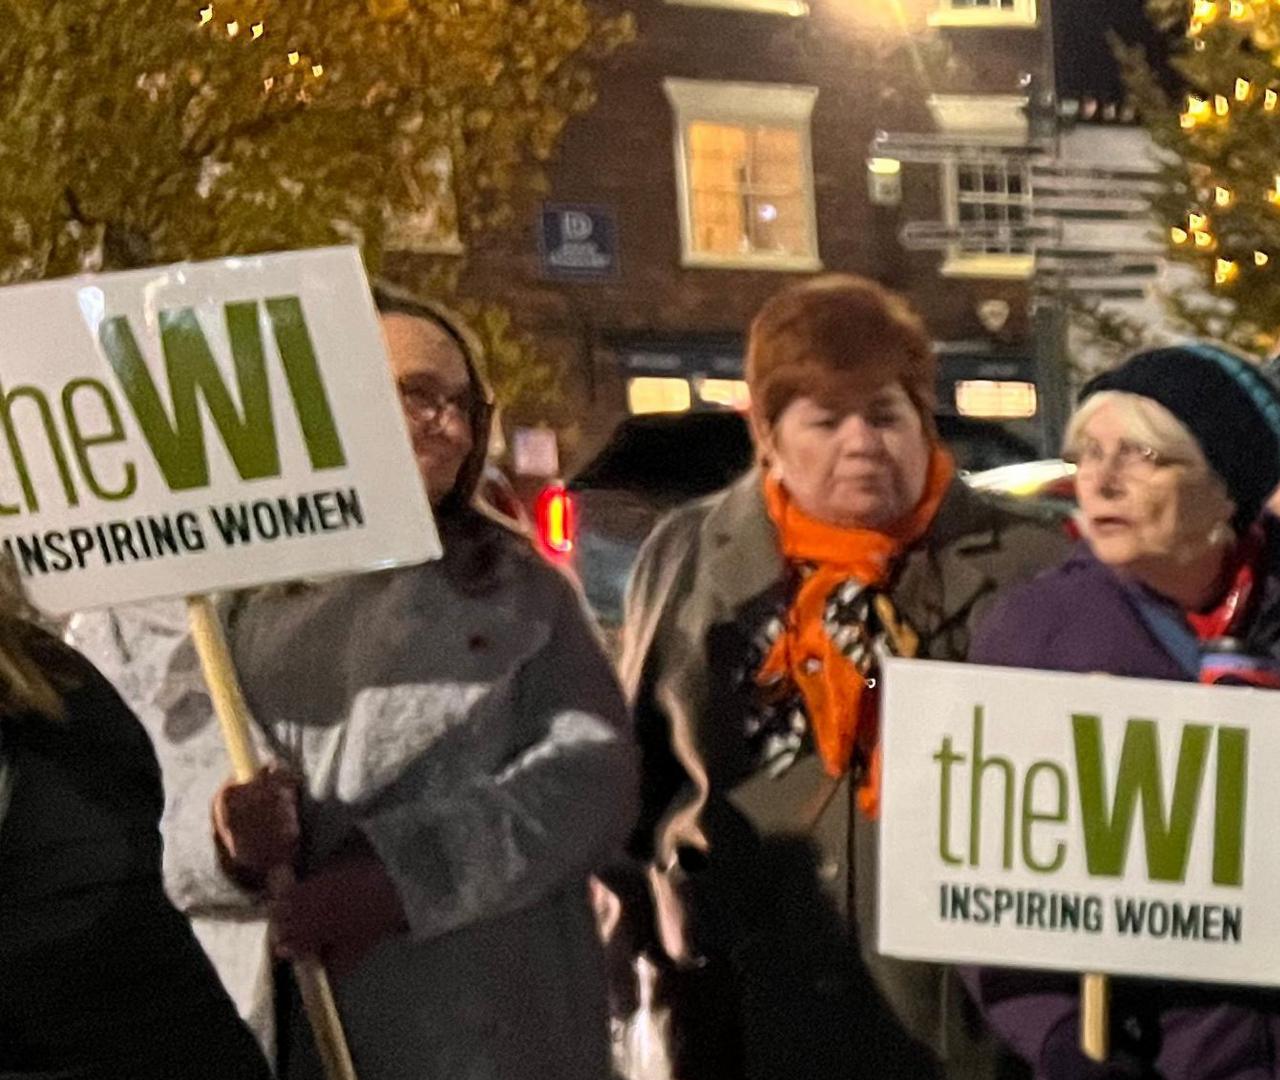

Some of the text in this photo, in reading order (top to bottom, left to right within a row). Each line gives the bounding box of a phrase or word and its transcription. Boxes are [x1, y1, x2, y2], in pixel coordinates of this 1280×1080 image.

[210, 488, 365, 548] WOMEN
[939, 884, 1243, 943] INSPIRING WOMEN
